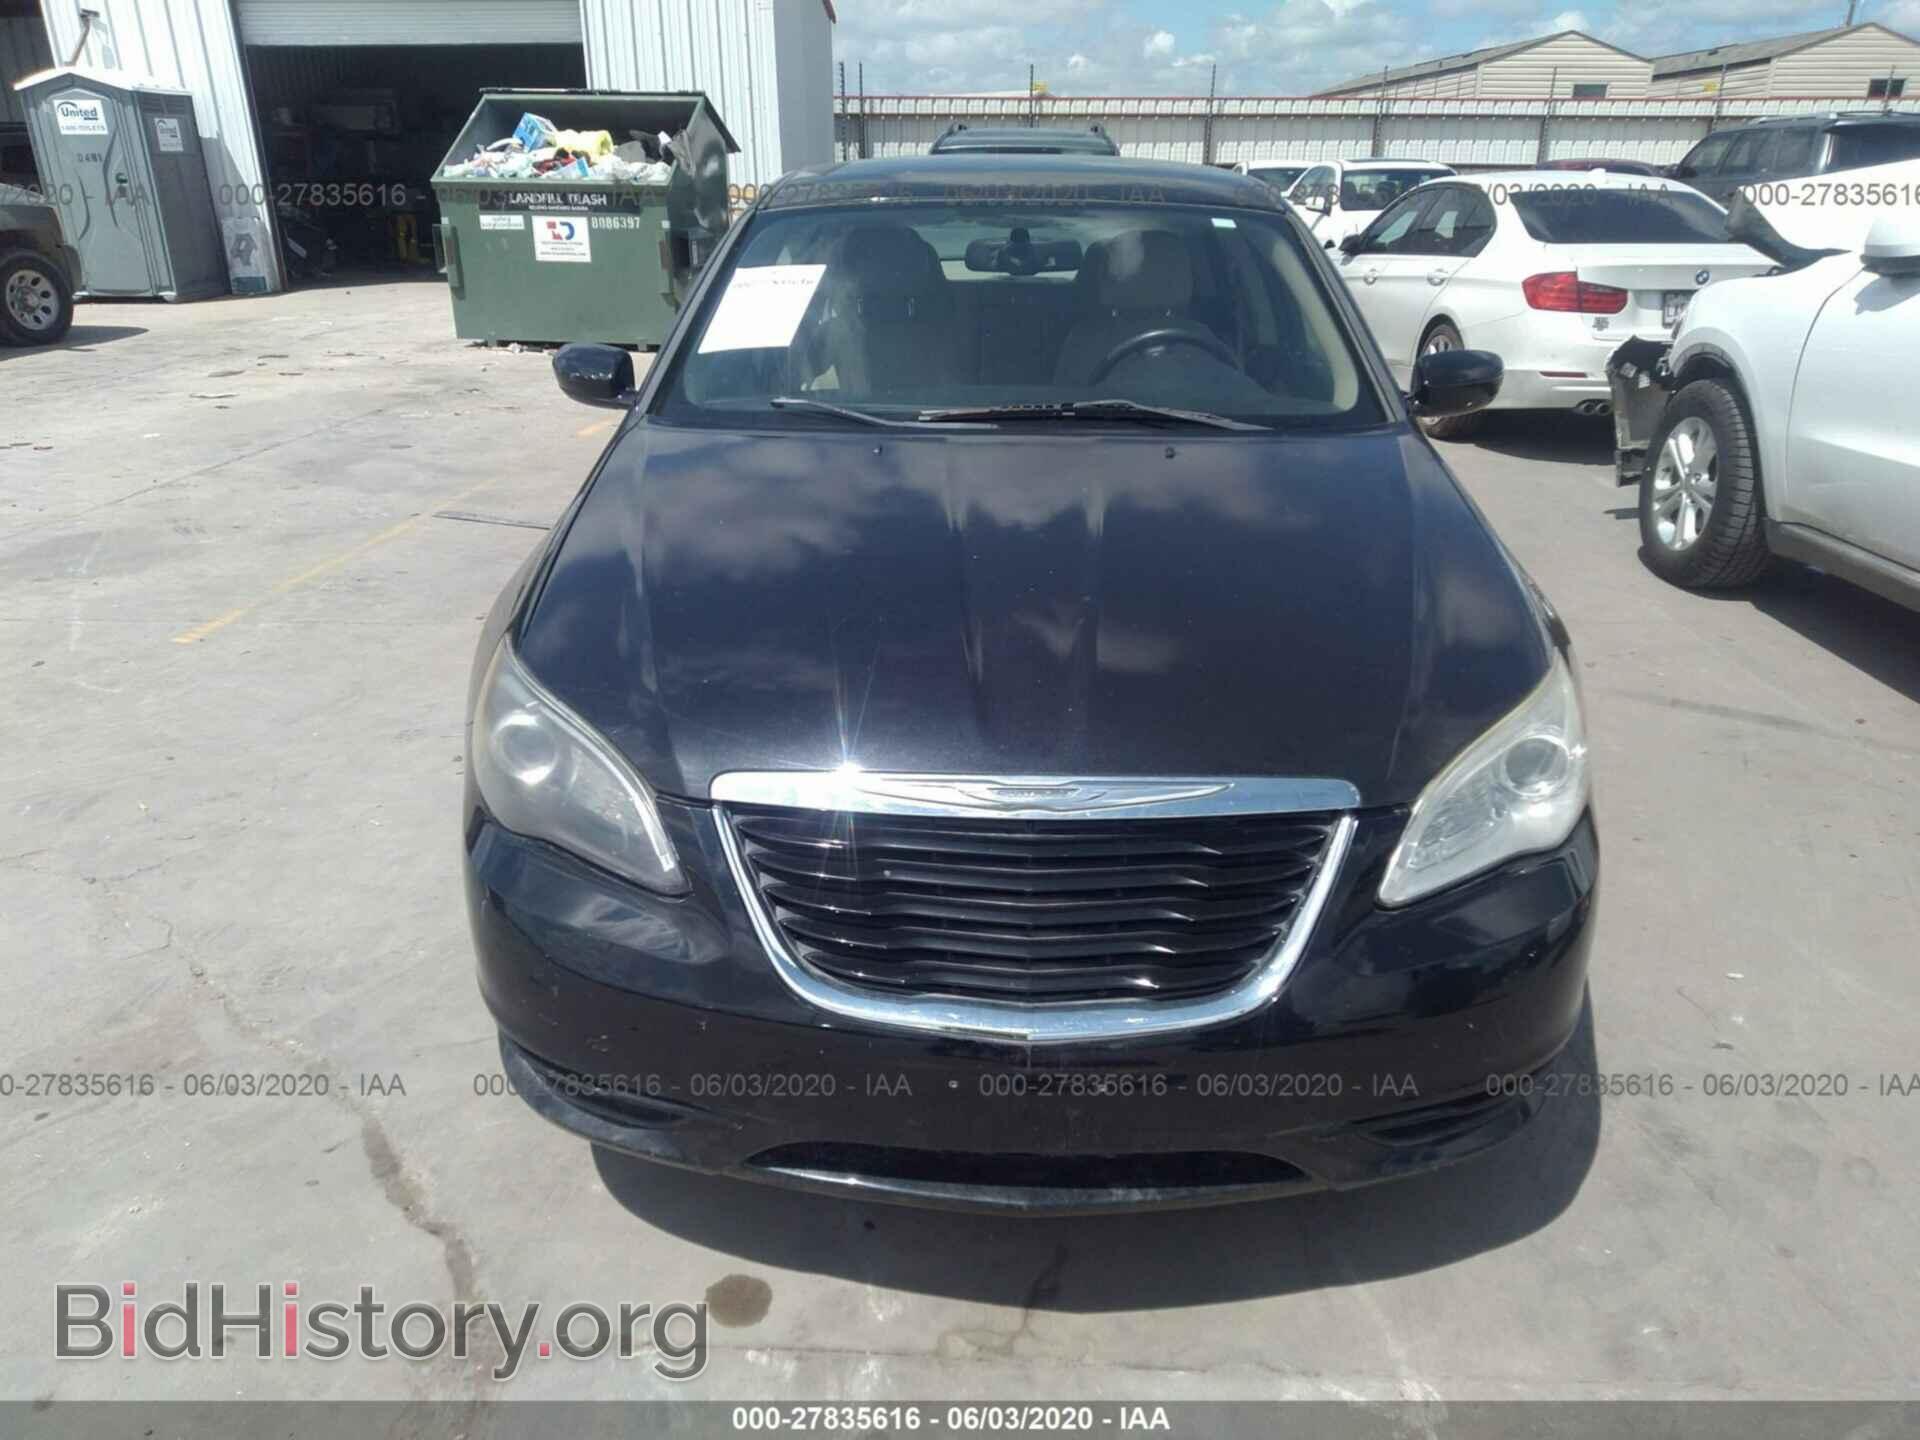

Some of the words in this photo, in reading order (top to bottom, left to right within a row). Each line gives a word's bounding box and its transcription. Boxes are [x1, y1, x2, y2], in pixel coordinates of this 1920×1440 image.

[61, 107, 97, 117] United
[508, 191, 562, 205] LANDFILL
[567, 193, 607, 206] TRASH
